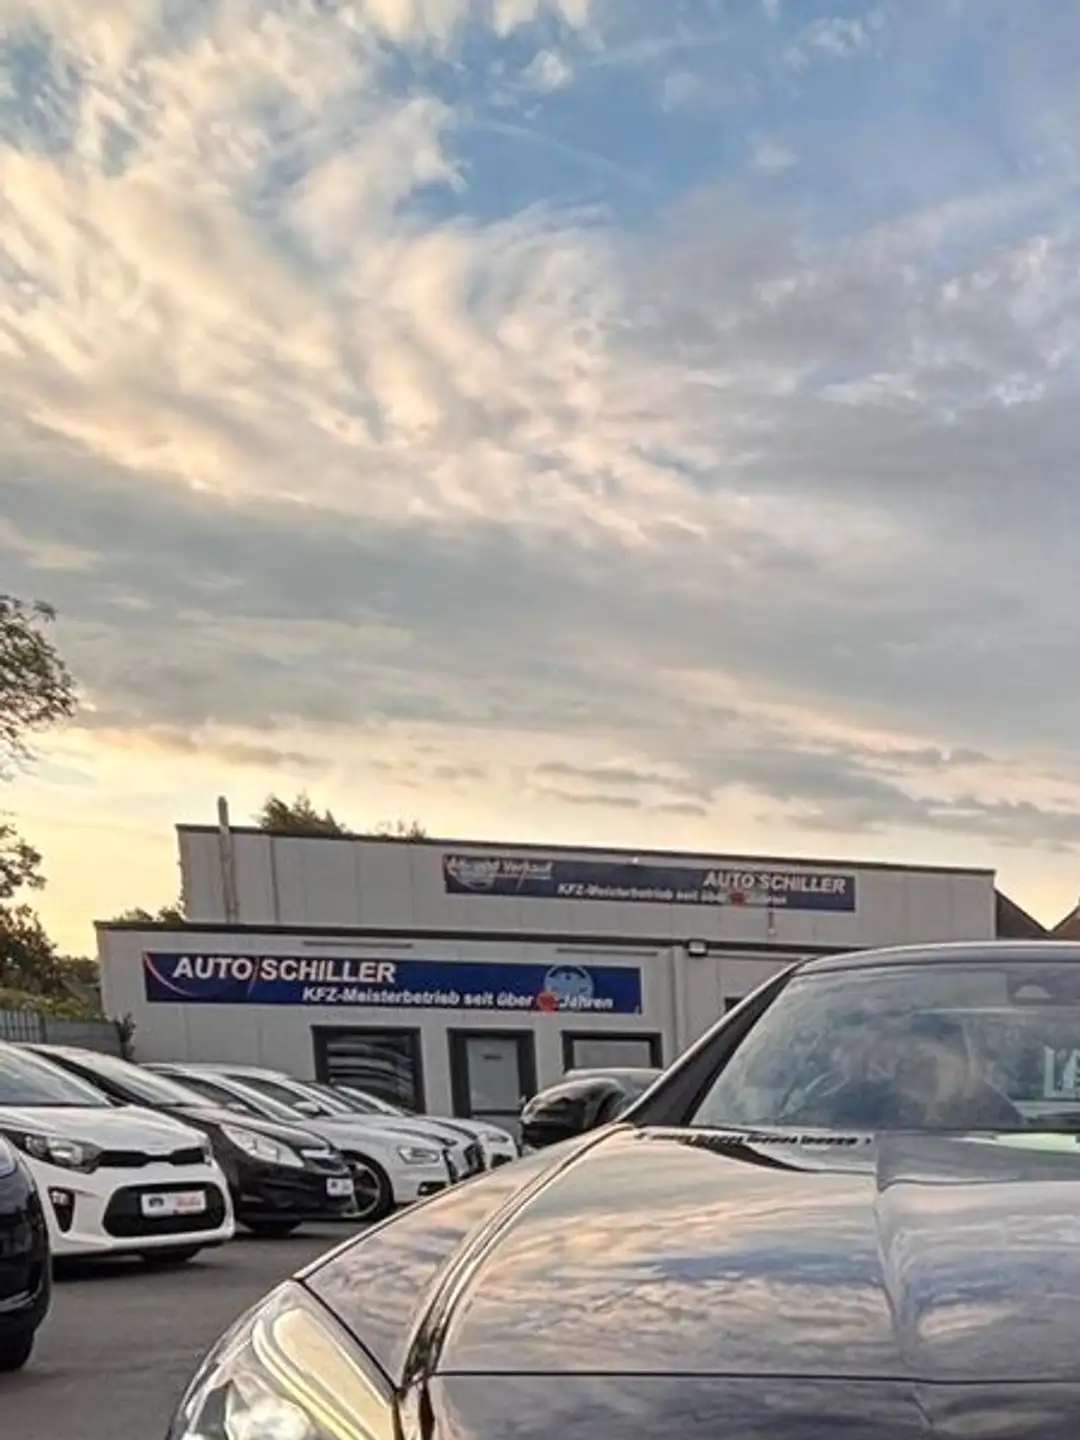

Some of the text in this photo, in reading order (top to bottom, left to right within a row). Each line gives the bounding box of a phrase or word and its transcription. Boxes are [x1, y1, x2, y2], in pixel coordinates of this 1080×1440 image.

[702, 870, 847, 894] AUTO SCHILLER
[172, 956, 397, 983] AUTO SCHILLER
[303, 986, 460, 1005] KFZ-Meisterbetrieb
[463, 990, 494, 1006] seit
